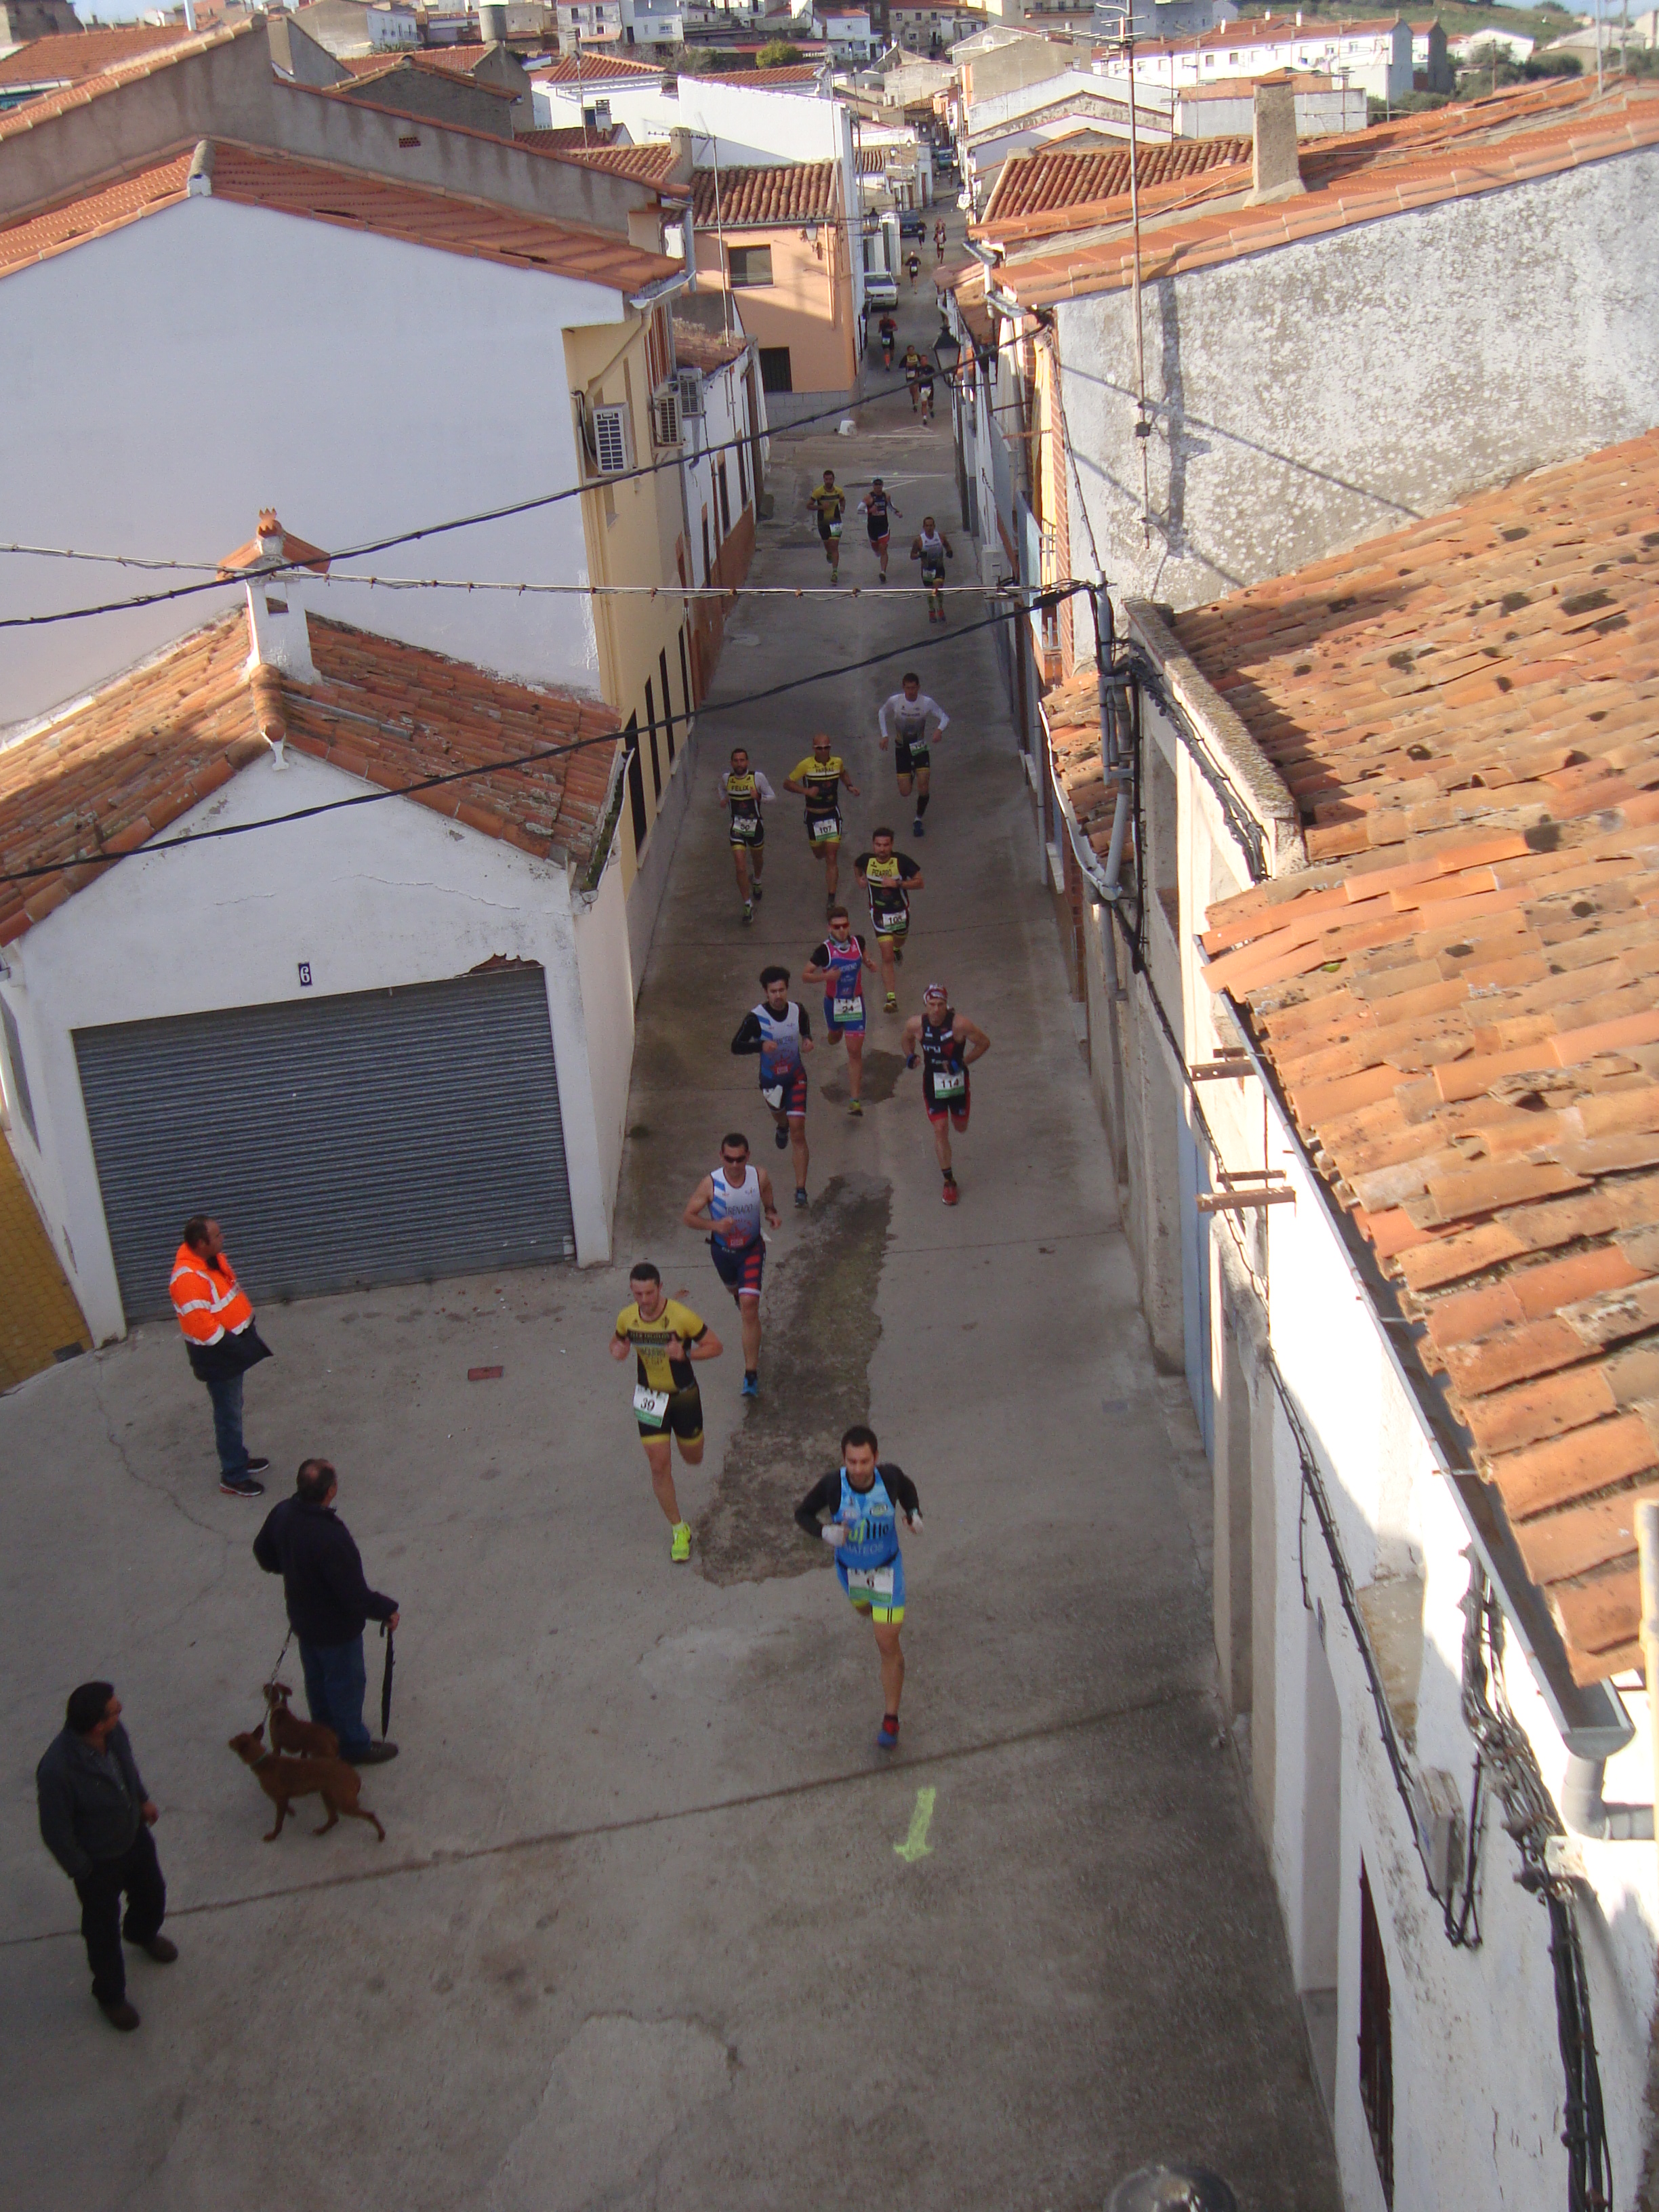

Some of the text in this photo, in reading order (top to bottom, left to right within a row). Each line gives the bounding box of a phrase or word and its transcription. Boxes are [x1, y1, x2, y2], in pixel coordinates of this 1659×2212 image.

[819, 825, 832, 834] 107
[300, 966, 310, 983] 6
[842, 1004, 855, 1014] 24
[941, 1078, 960, 1088] 114
[724, 1204, 753, 1215] TRENADO
